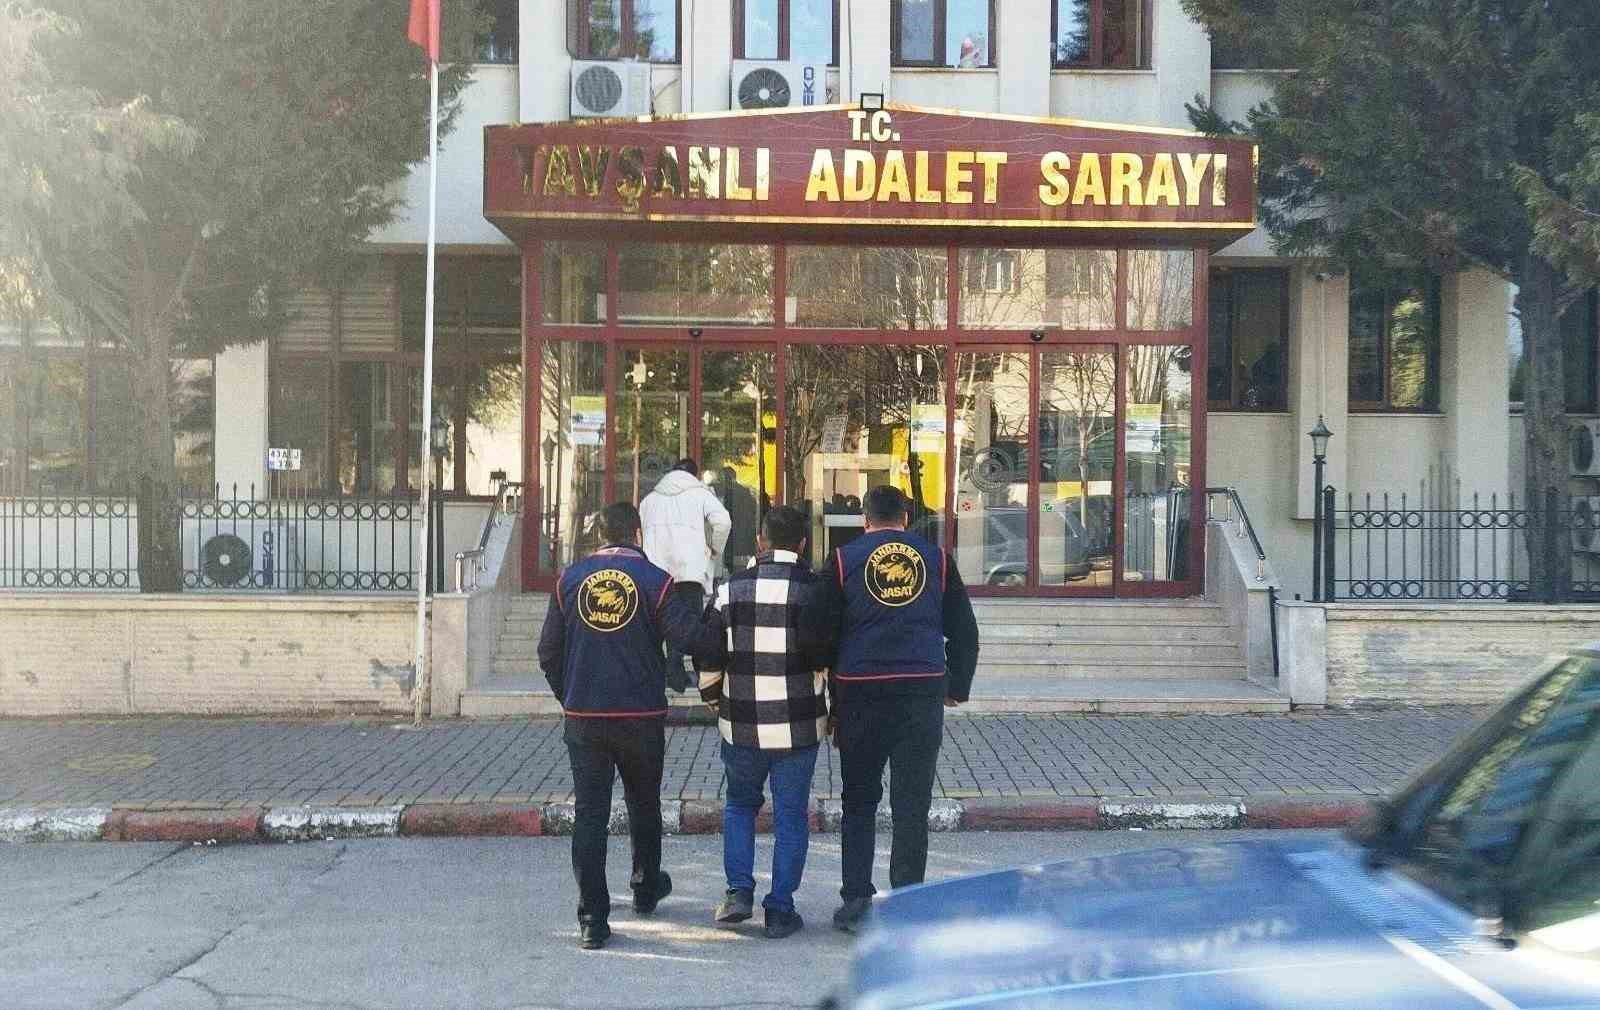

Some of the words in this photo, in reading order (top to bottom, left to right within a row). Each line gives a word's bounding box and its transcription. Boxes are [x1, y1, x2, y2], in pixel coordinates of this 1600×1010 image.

[803, 66, 815, 106] EKO
[848, 110, 901, 142] T.C.
[514, 143, 770, 213] TAVŞANLI
[804, 148, 1008, 204] ADALET
[1038, 150, 1228, 207] SARAYI
[880, 585, 913, 599] JASAT
[588, 610, 622, 624] JASAT
